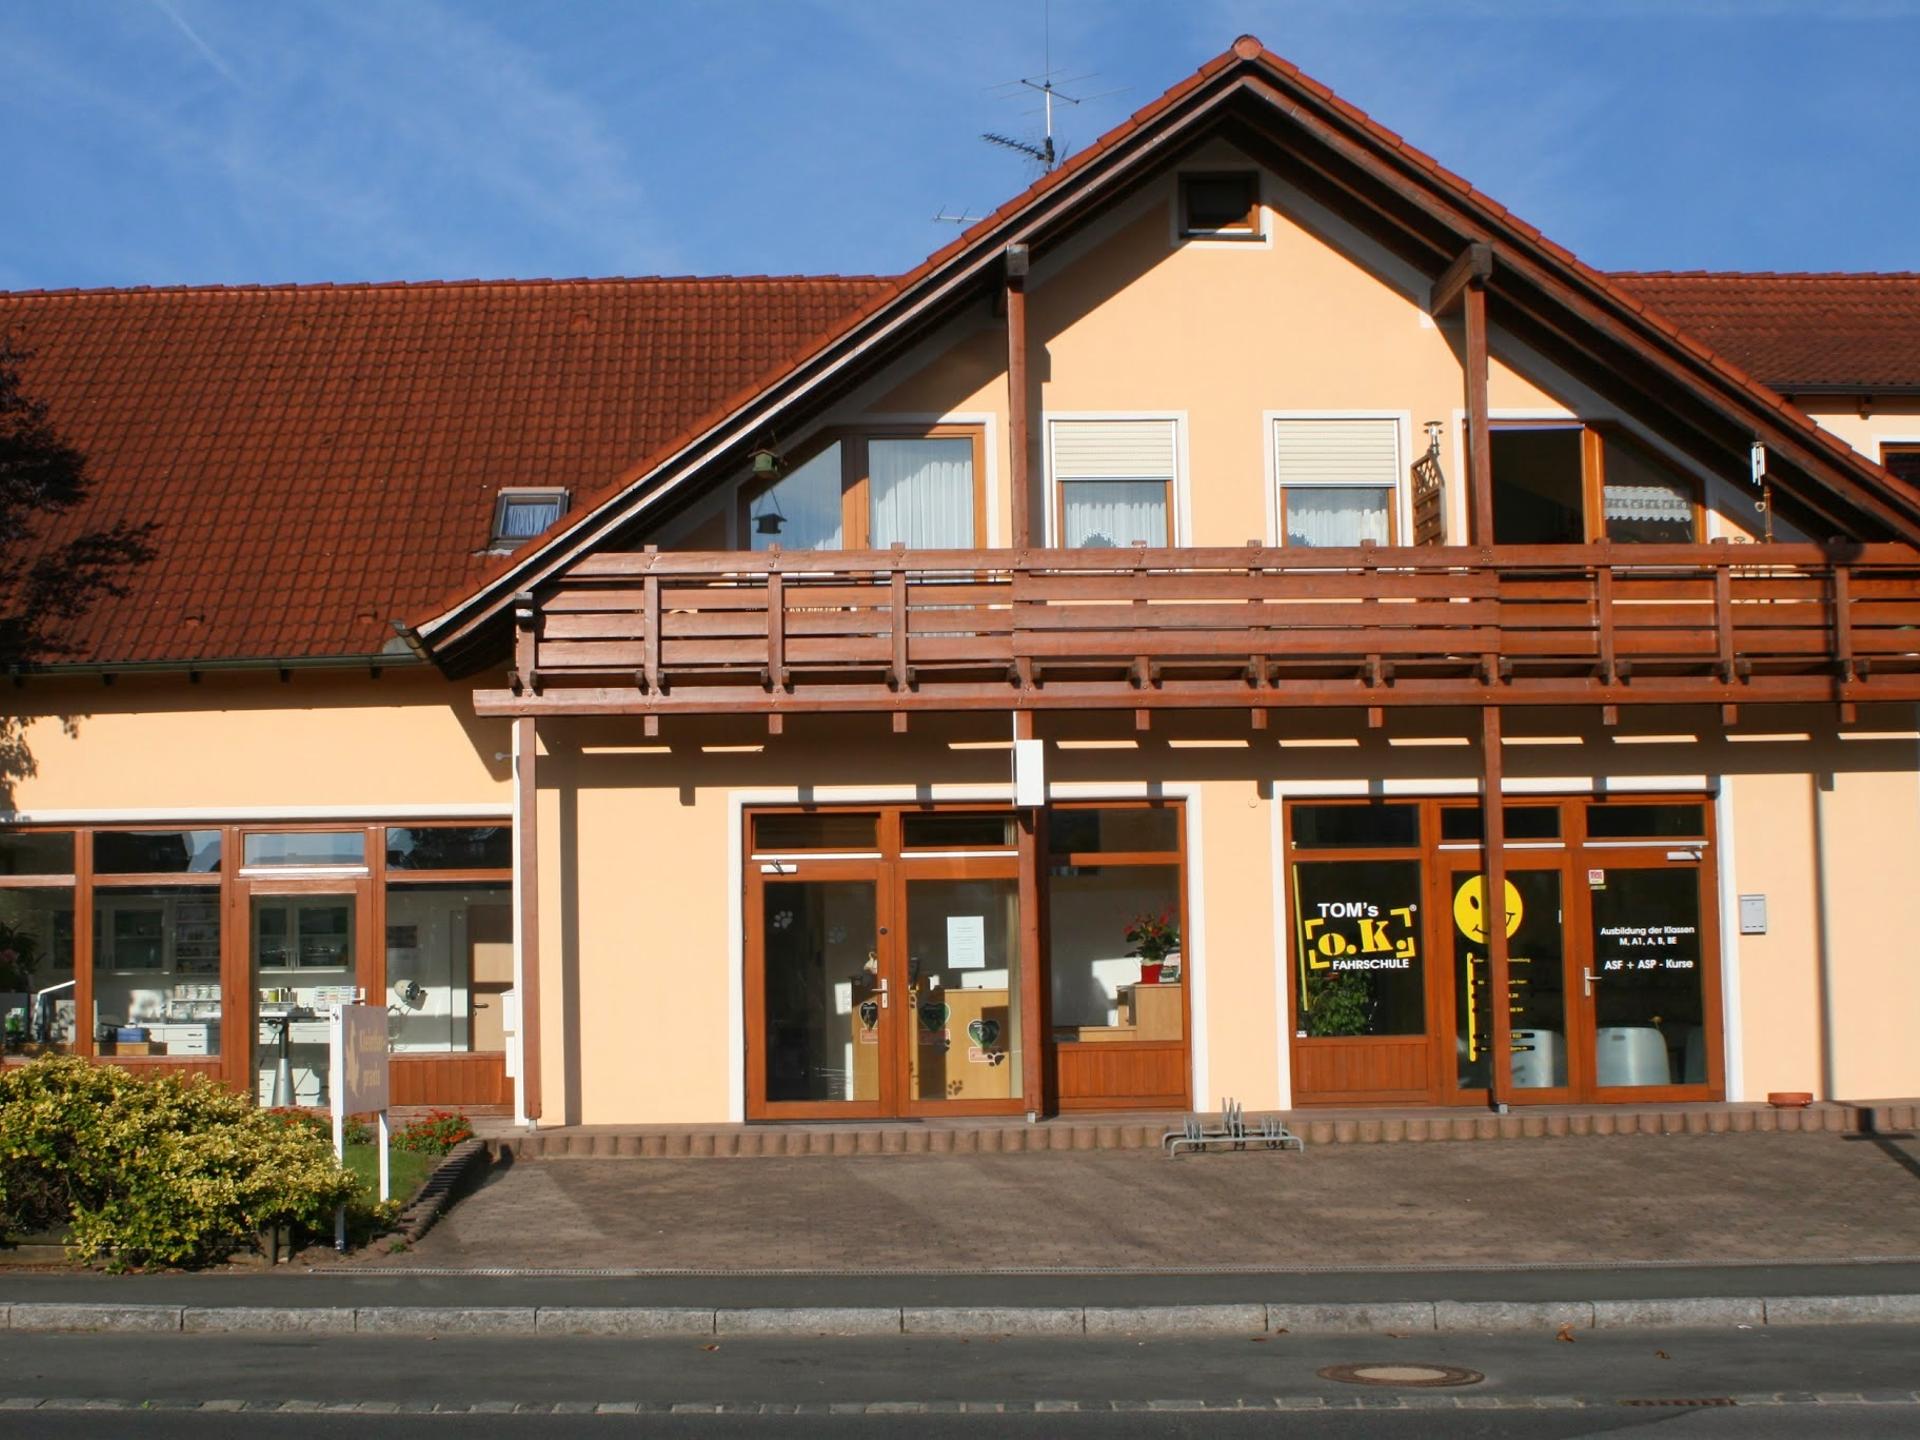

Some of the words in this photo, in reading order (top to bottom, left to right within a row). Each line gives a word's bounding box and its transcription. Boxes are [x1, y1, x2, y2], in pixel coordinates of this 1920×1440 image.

[1317, 902, 1379, 918] TOM's
[1600, 927, 1646, 936] Ausbildung
[1648, 926, 1662, 935] der
[1664, 925, 1695, 934] Klassen
[1333, 959, 1409, 970] FAHRSCHULE
[1604, 960, 1623, 970] ASF
[1637, 959, 1657, 969] ASP
[1665, 958, 1694, 969] Kurse
